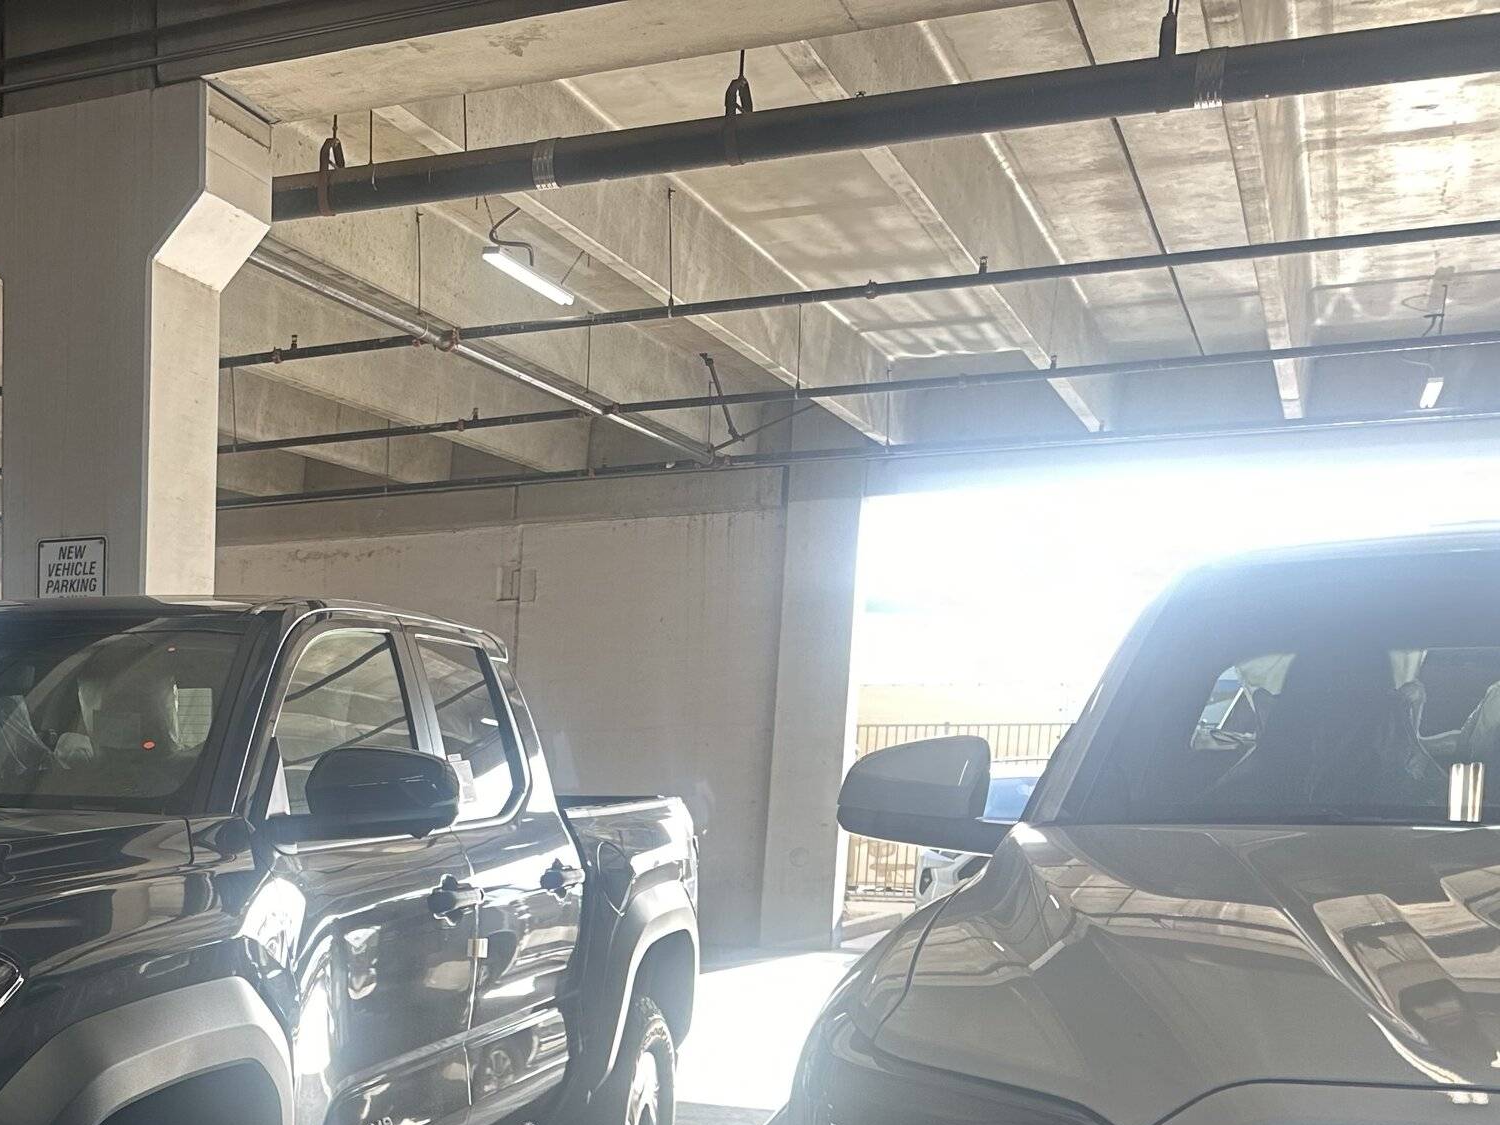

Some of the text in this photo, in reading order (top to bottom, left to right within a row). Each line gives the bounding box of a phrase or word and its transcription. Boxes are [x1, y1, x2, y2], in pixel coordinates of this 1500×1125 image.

[58, 545, 87, 560] NEW
[47, 561, 97, 577] VEHICLE
[45, 577, 98, 594] PARKING
